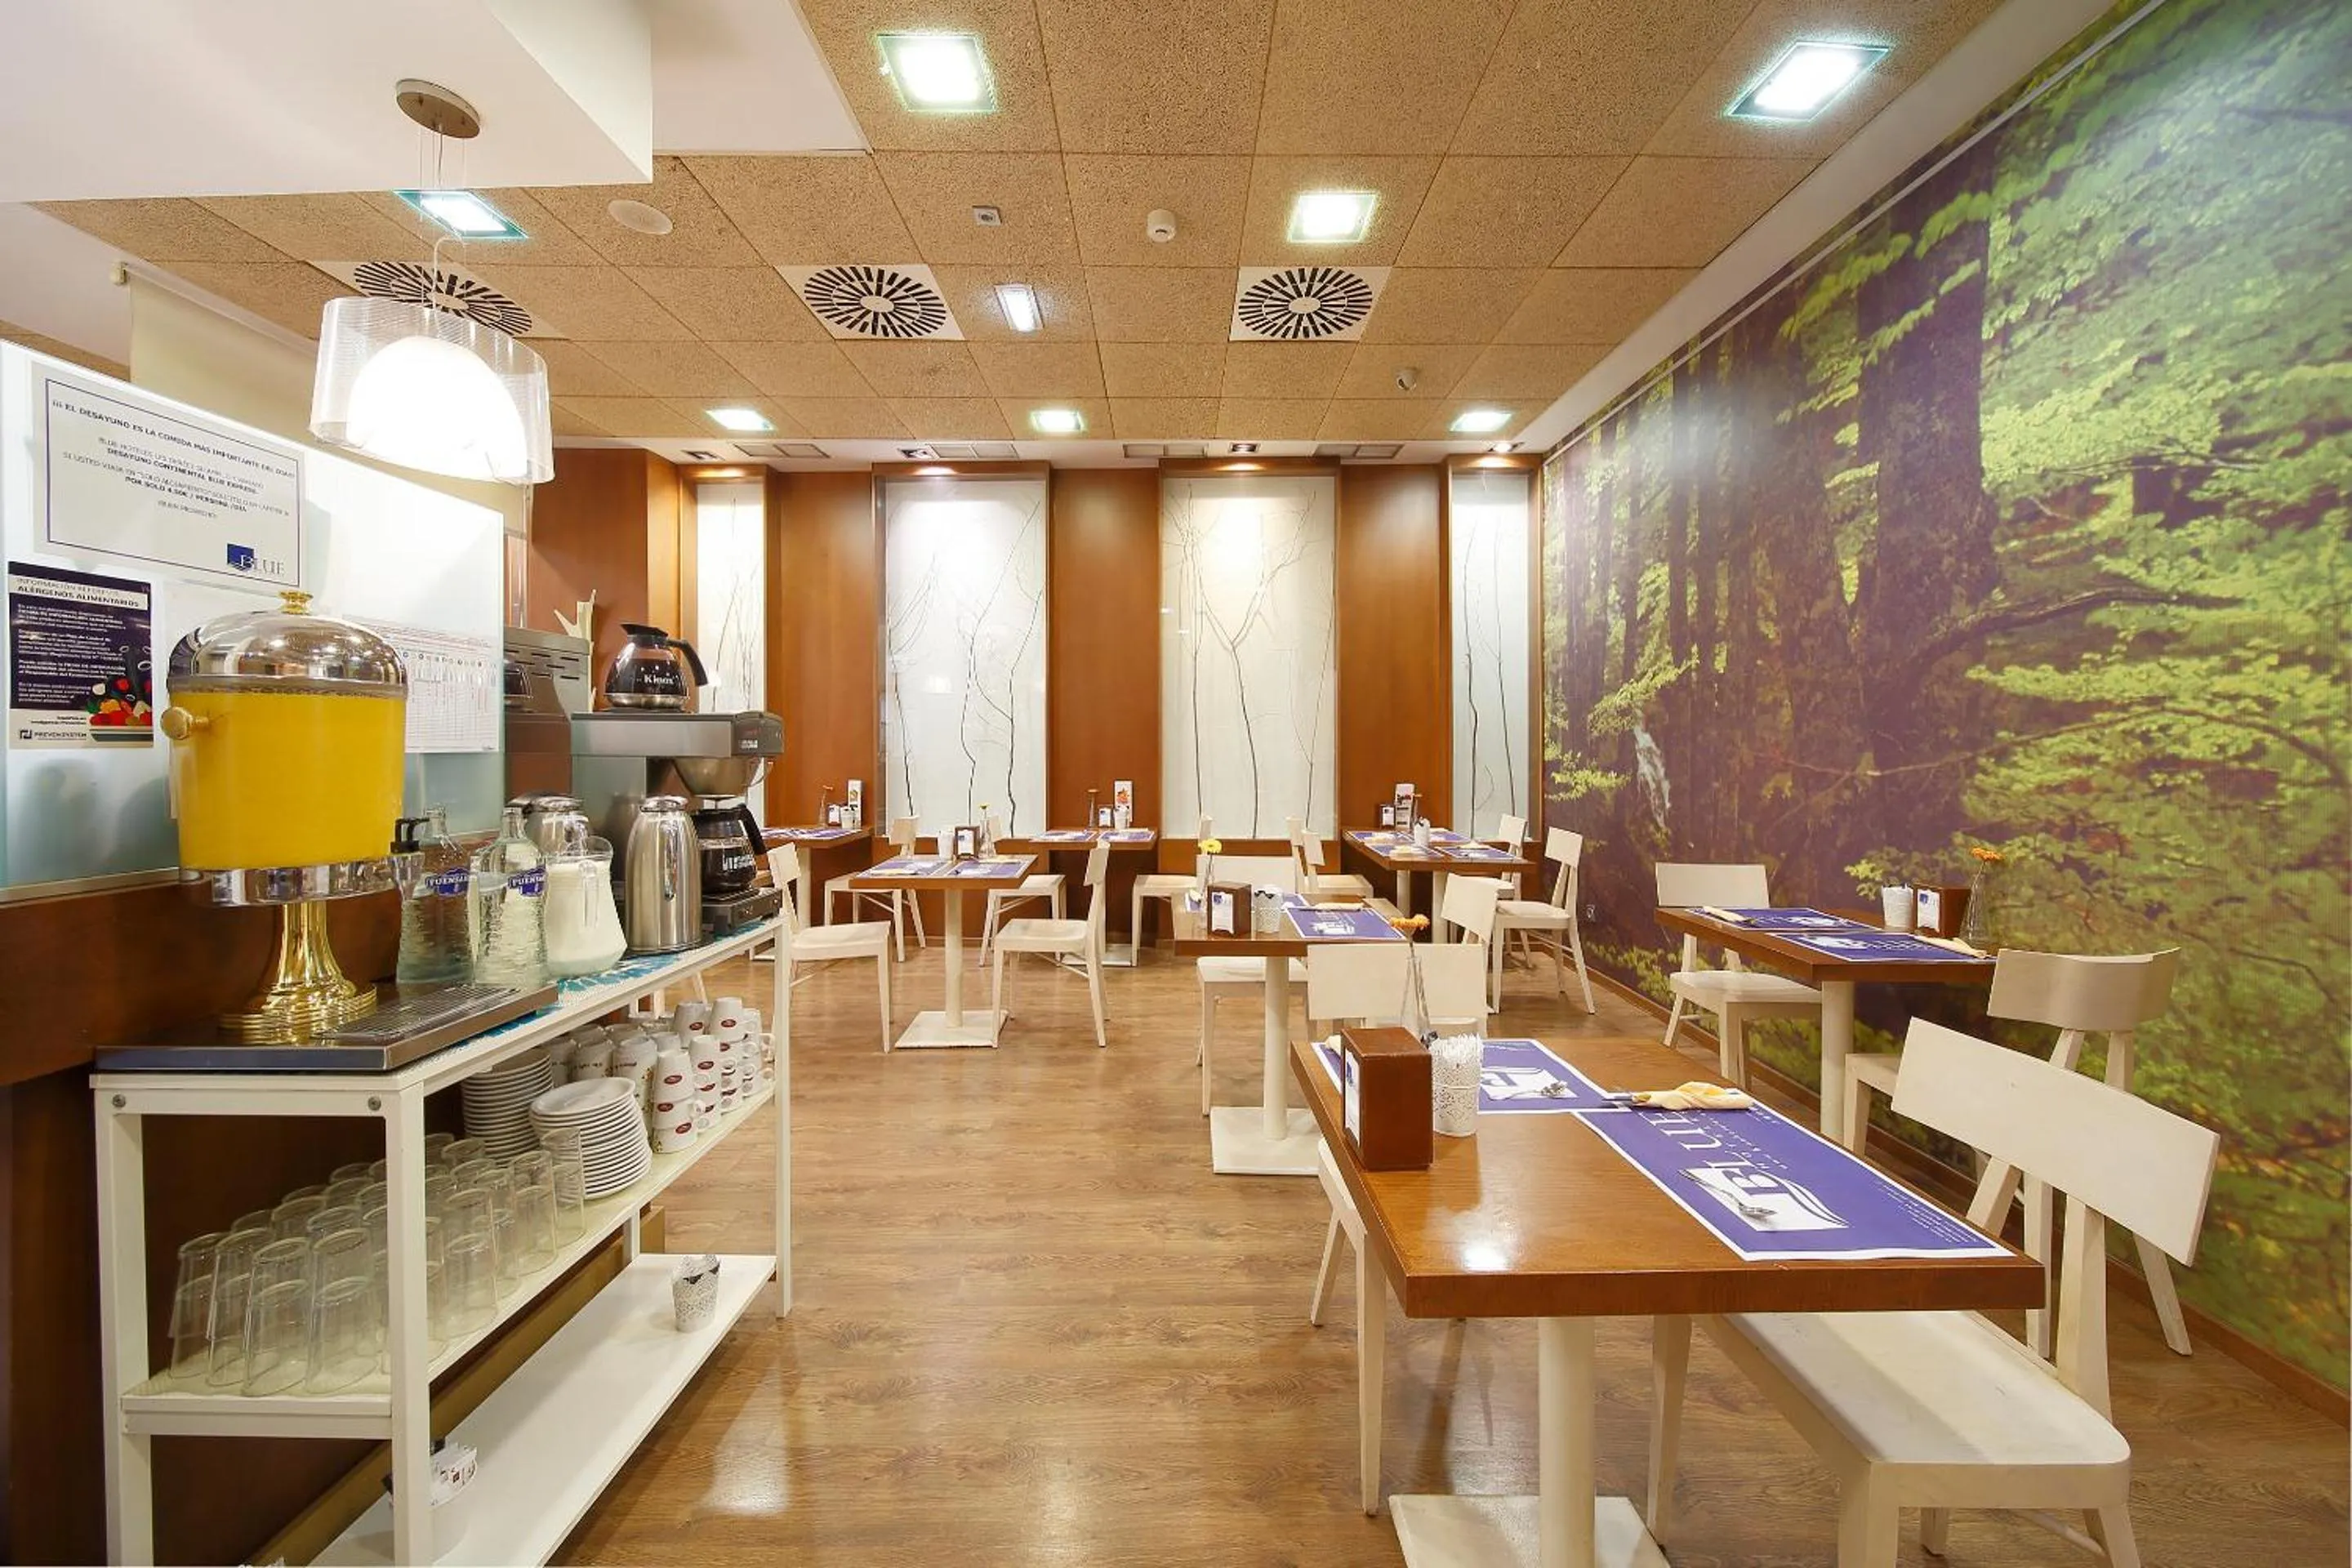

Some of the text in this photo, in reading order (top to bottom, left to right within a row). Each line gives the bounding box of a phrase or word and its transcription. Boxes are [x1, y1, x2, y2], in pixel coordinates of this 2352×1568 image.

[65, 403, 77, 412] EL
[79, 408, 131, 429] DESAYUNO
[132, 424, 144, 432] ES
[145, 427, 156, 437] LA
[107, 448, 152, 465] DESAYUNO
[1638, 1111, 1786, 1196] BLUE
